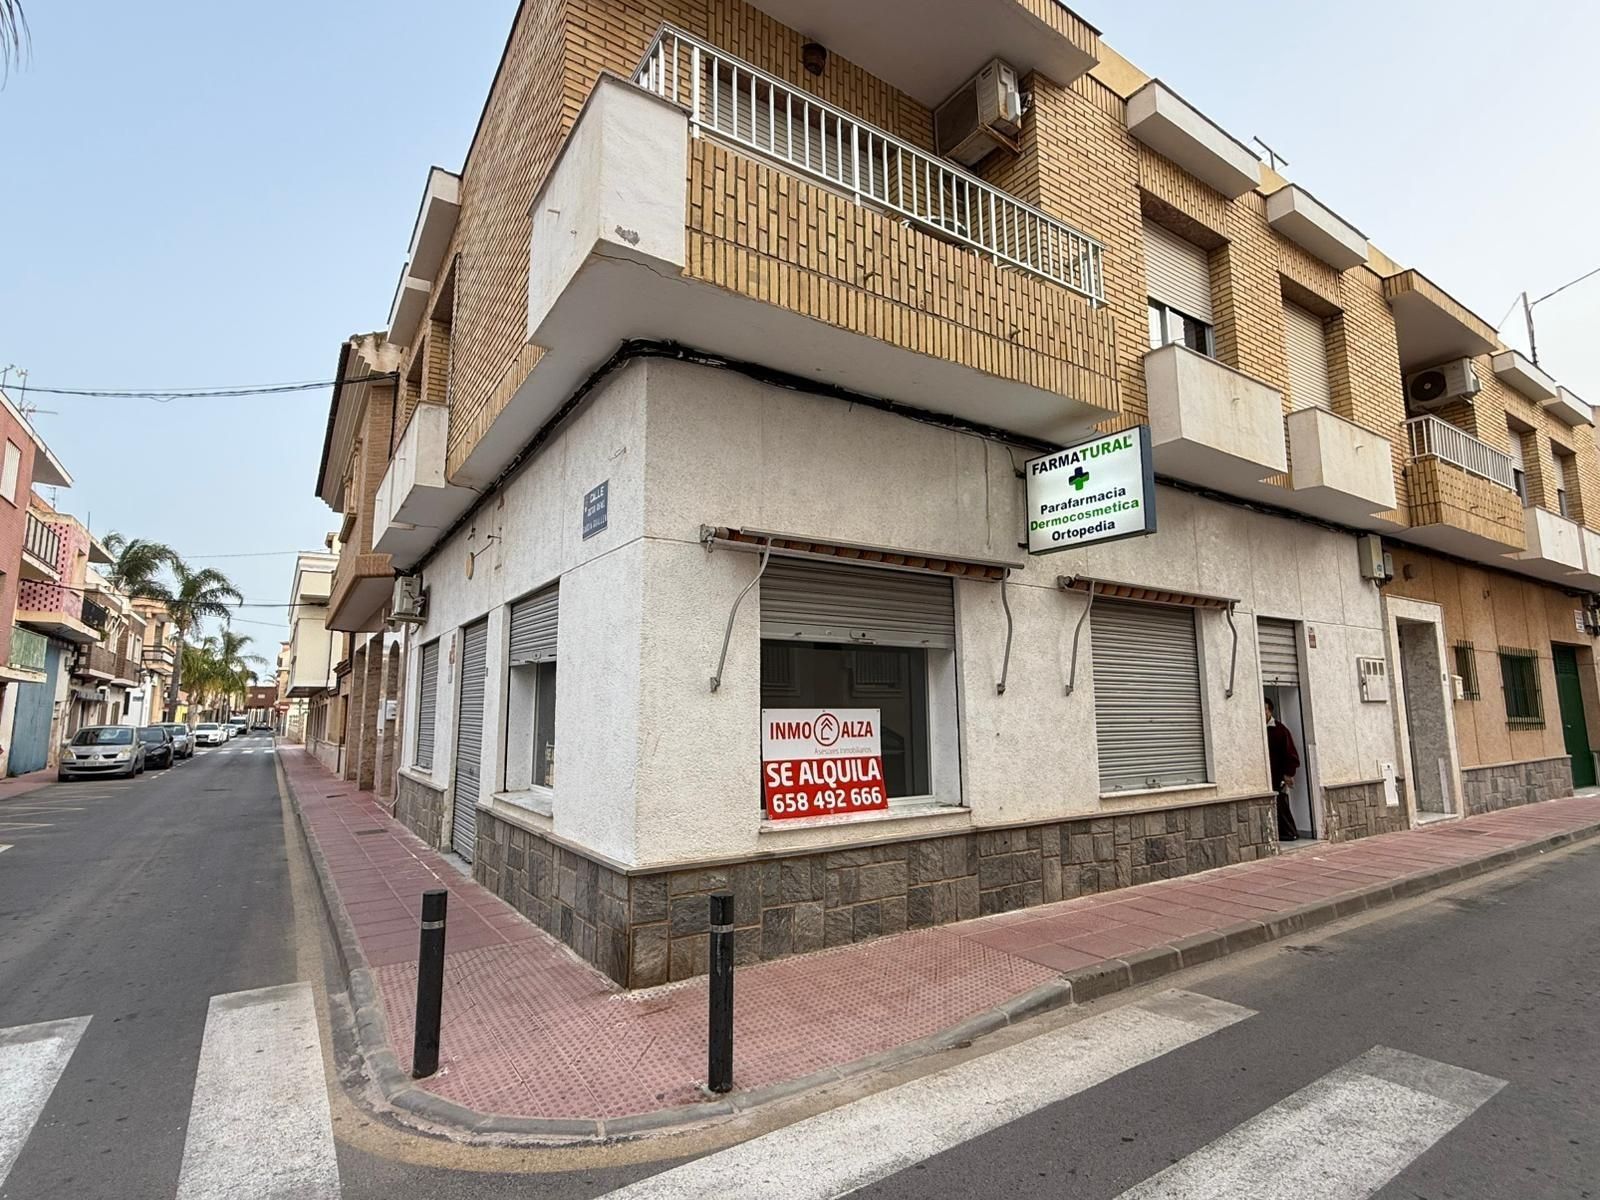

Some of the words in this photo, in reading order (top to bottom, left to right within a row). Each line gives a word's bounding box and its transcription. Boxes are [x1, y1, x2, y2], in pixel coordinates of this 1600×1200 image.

[1032, 436, 1133, 476] FARMATURAL
[1030, 499, 1139, 531] Dermocosmetica
[1040, 486, 1127, 515] Parafarmacia
[1051, 520, 1116, 541] Ortopedia
[770, 721, 812, 740] INMO
[841, 721, 873, 738] ALZA
[766, 762, 794, 788] SE
[799, 757, 881, 788] ALQUILA
[772, 792, 809, 813] 658
[813, 789, 847, 809] 492
[850, 786, 882, 806] 666
